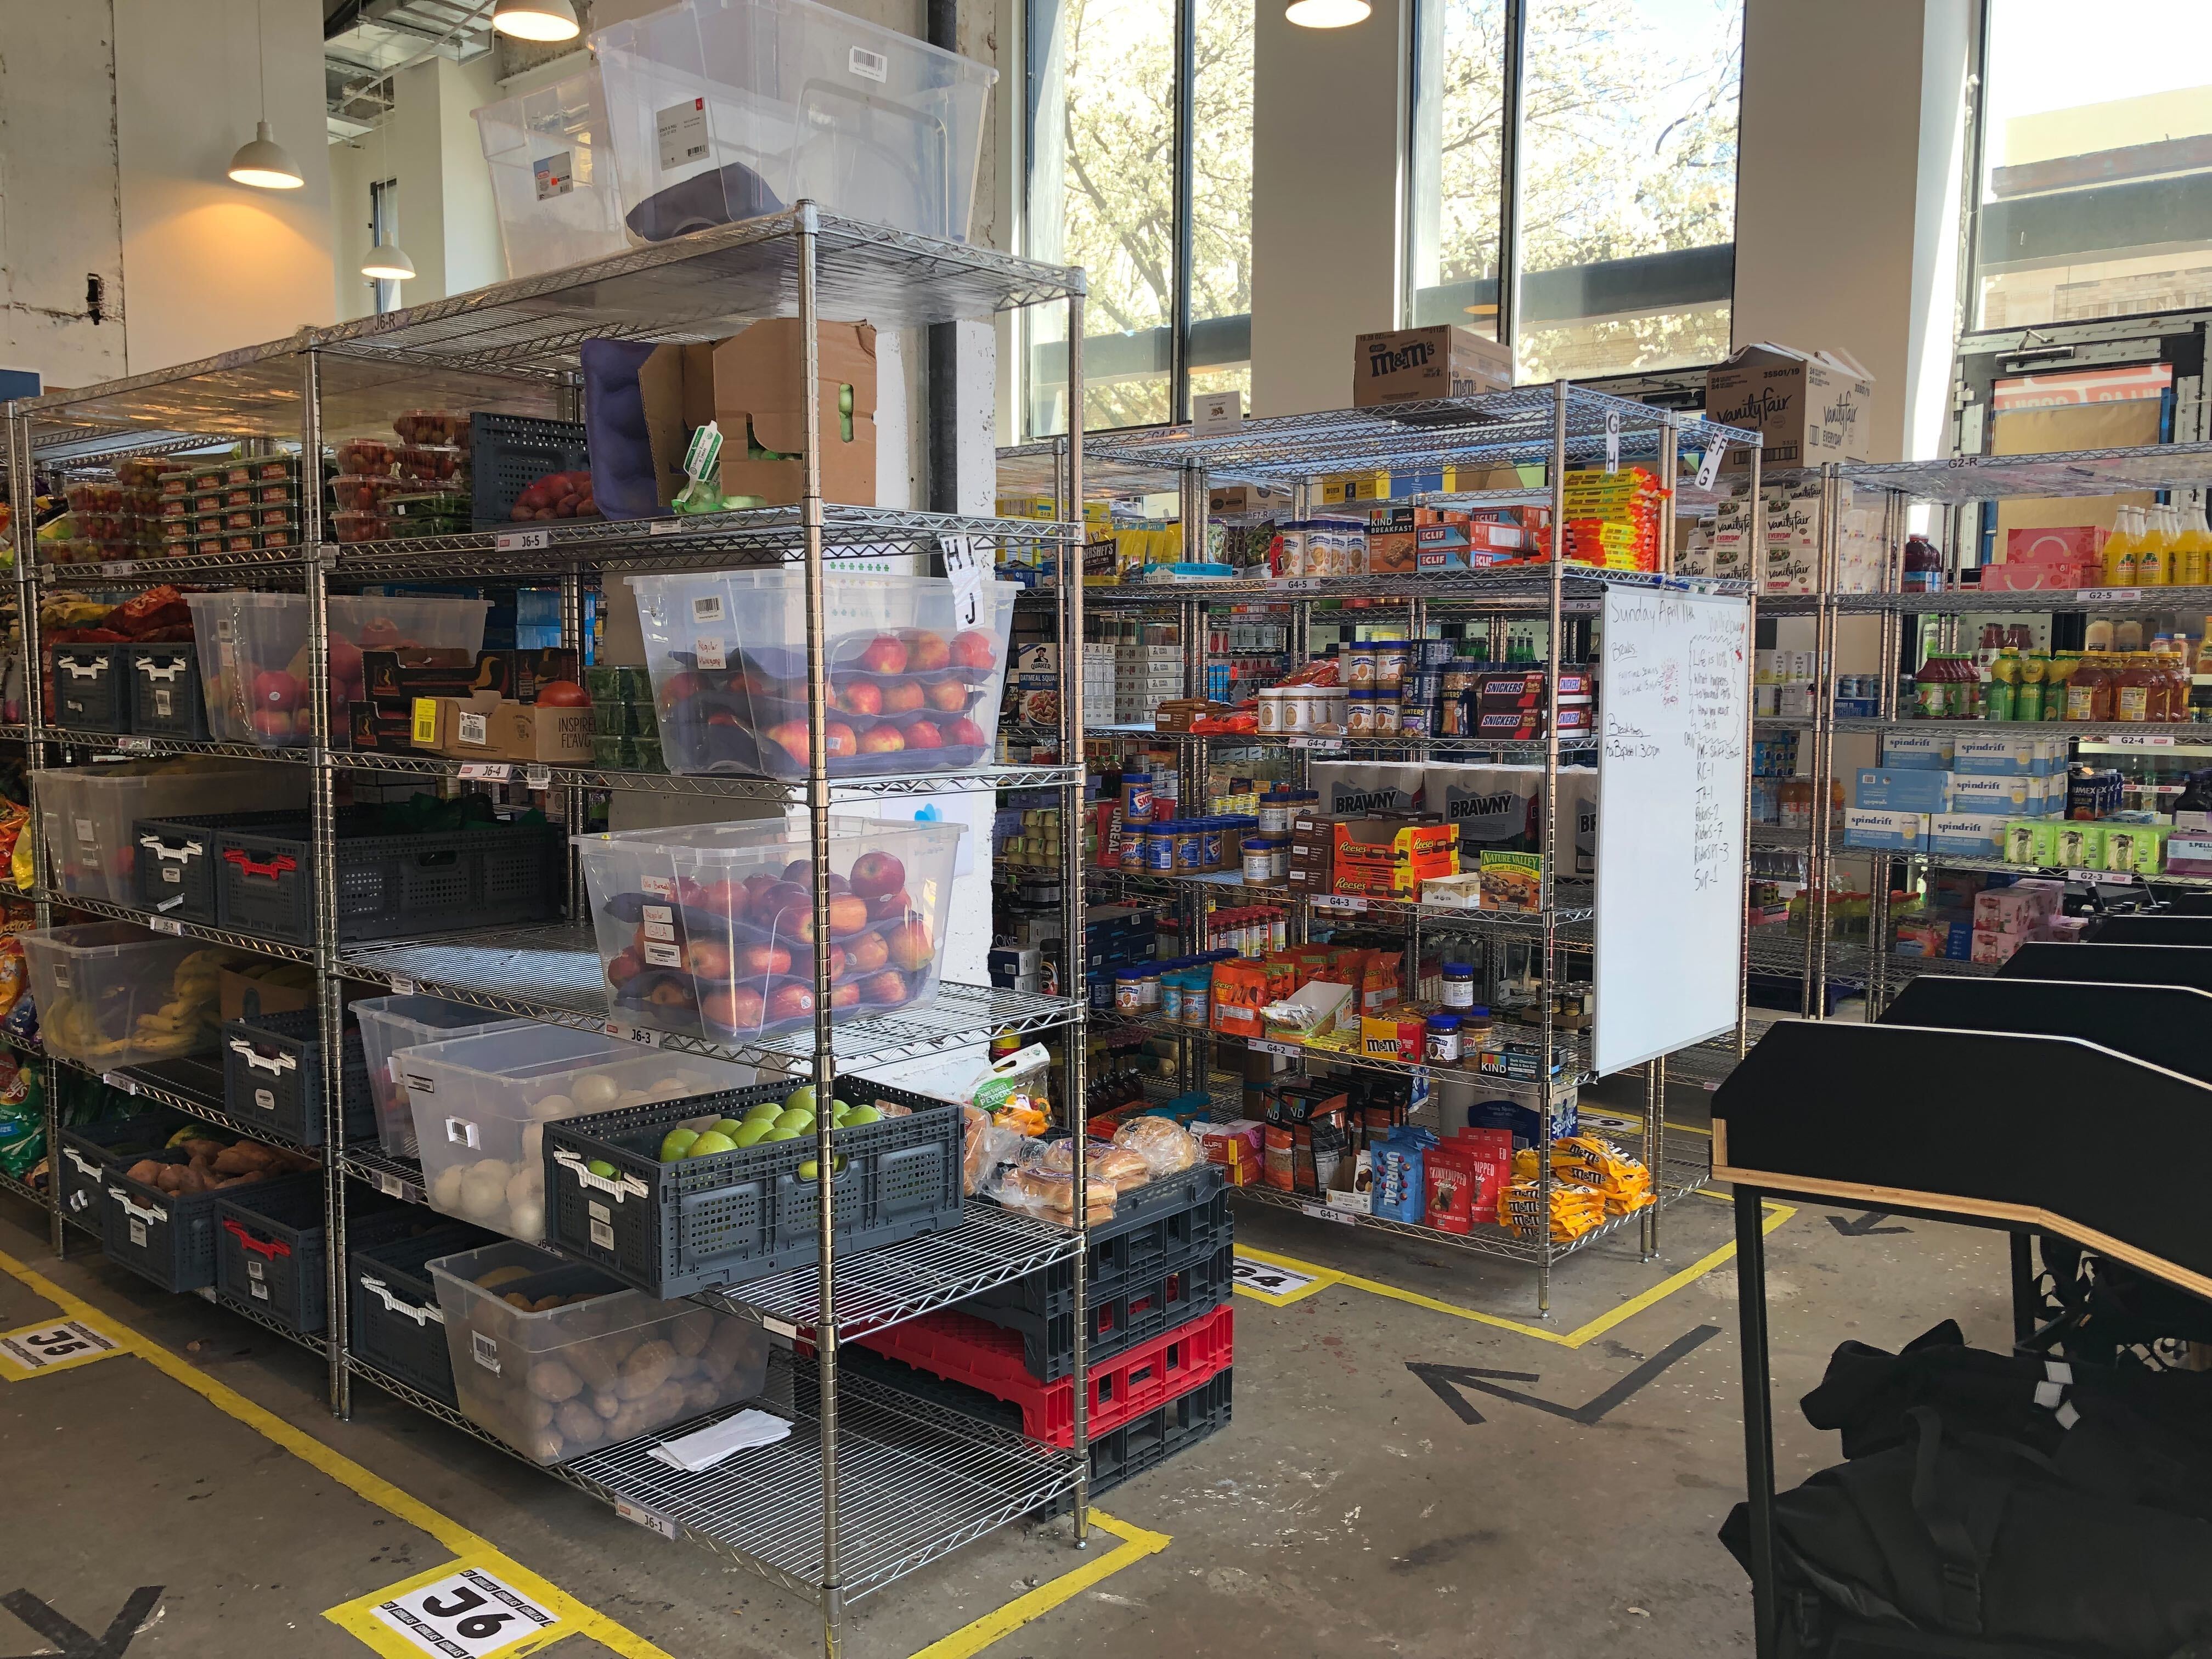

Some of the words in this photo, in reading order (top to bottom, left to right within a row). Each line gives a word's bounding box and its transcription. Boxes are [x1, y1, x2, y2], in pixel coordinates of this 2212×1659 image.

[1608, 413, 1618, 435] G
[1607, 452, 1616, 471] H
[1948, 457, 1977, 469] G2-R
[1699, 467, 1710, 486] G
[1372, 517, 1392, 527] KIND
[1372, 525, 1413, 533] BREAKFAST
[522, 535, 539, 547] J6-5
[1426, 532, 1444, 540] CLIF
[1426, 555, 1444, 565] CLIF
[966, 592, 975, 624] J
[1611, 596, 1655, 634] Sunday
[1660, 600, 1679, 627] April
[1486, 682, 1523, 693] SNICKERS
[1560, 678, 1581, 690] SNICKERS
[1482, 715, 1520, 726] SNICKERS
[1558, 712, 1579, 724] SNICKERS
[1307, 739, 1327, 748] G4-4
[1889, 738, 1931, 748] spindrift
[1961, 743, 2006, 753] spindrift
[482, 765, 501, 776] J6-4
[1956, 781, 2000, 792] spindrift
[1335, 791, 1397, 814] BRAWNY
[1450, 795, 1513, 818] BRAWNY
[1852, 815, 1892, 826] spindrift
[1938, 822, 1981, 832] spindrift
[1339, 841, 1367, 853] Reese's
[1413, 837, 1434, 850] Reese's
[1483, 853, 1511, 864] NATURE
[1512, 856, 1538, 869] VALLEY
[2080, 872, 2103, 881] G2-3
[1335, 877, 1367, 891] Reese's
[1330, 898, 1350, 906] G4-3
[631, 1028, 651, 1045] J6-3
[1267, 1044, 1285, 1054] G4-2
[1366, 1039, 1402, 1053] m&m's
[1481, 1063, 1506, 1074] KIND
[979, 1089, 1013, 1107] PEPPERS
[1384, 1152, 1401, 1206] UNREAL
[1320, 1210, 1339, 1220] G4-1
[26, 1330, 91, 1356] J5
[644, 1514, 664, 1533] J6-1
[422, 1586, 516, 1639] J6
